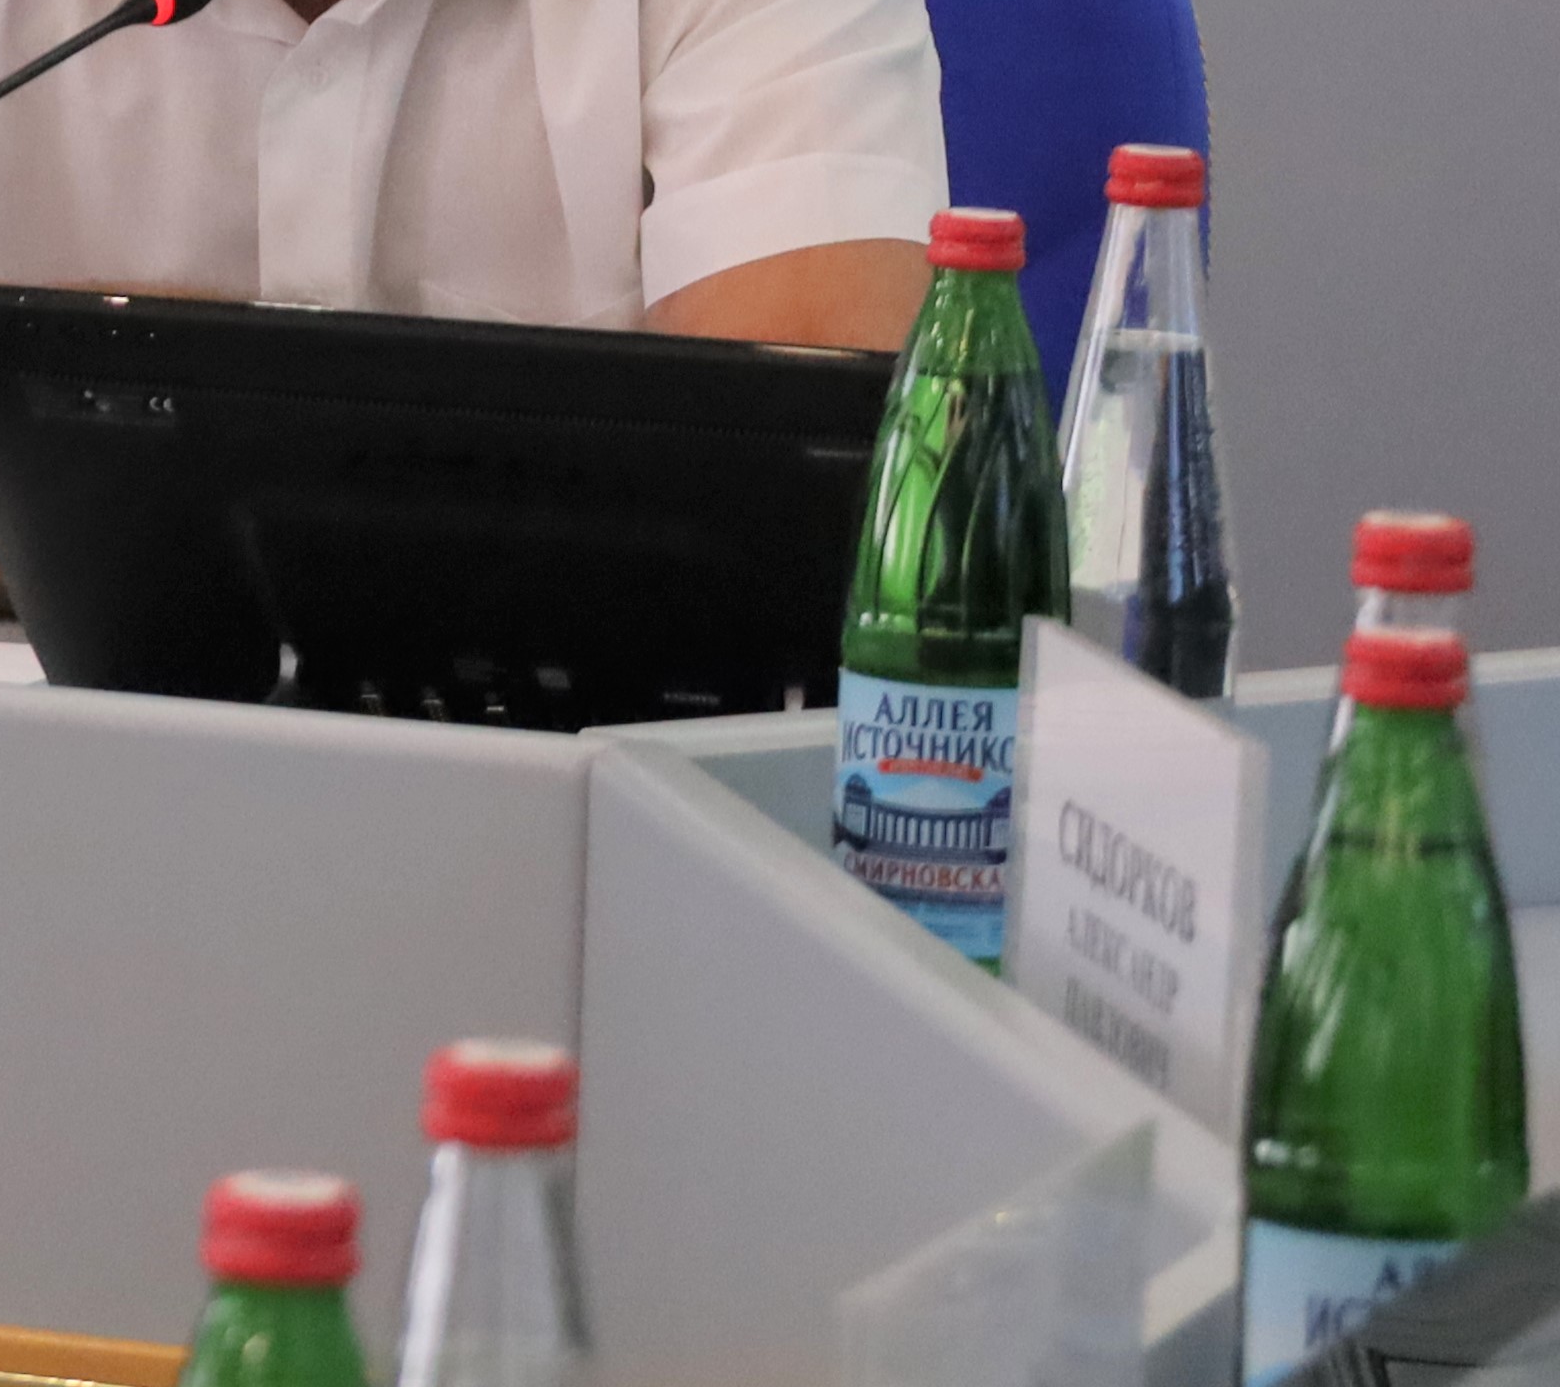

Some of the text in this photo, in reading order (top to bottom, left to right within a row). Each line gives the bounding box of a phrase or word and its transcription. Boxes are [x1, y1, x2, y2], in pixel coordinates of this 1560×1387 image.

[874, 692, 994, 732] АЛЛЕЯ
[842, 721, 1015, 774] ИСТОЧНИКО
[843, 849, 1003, 891] СМИРНОВСКА
[1059, 798, 1196, 944] СИДОРКОВ
